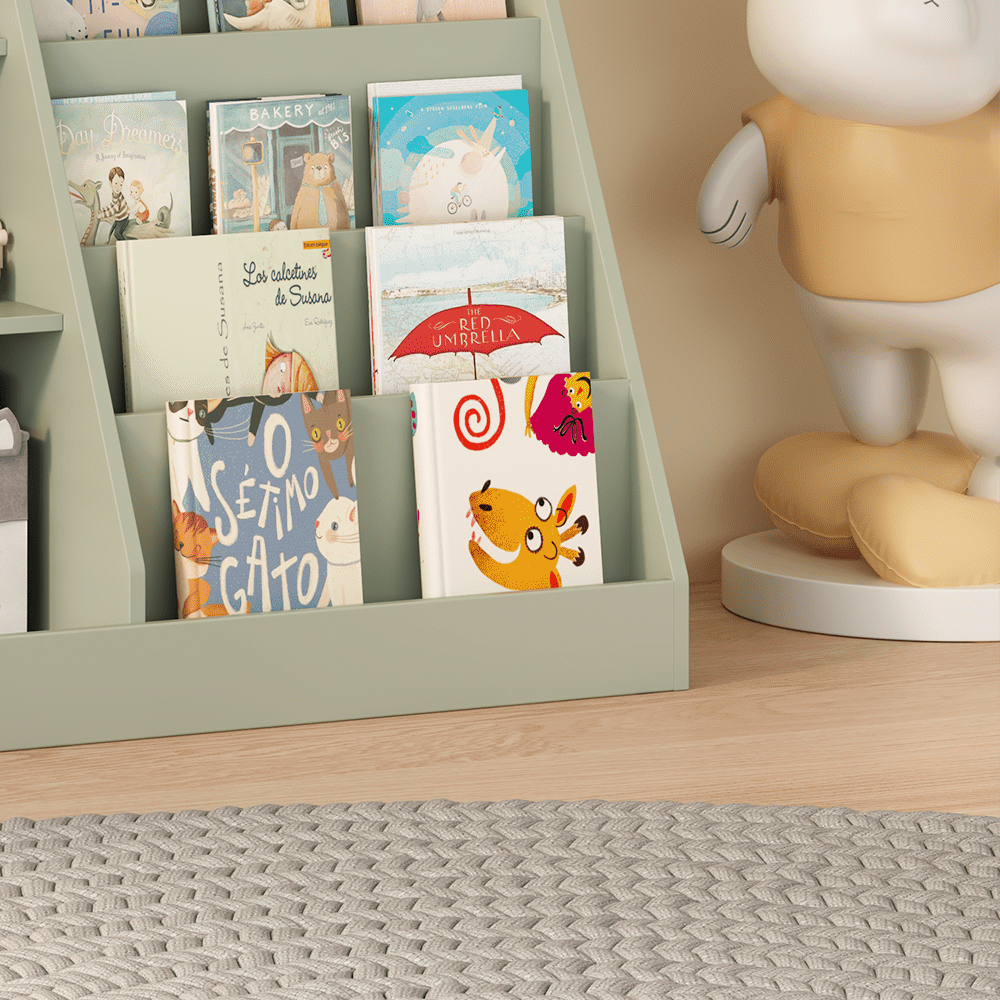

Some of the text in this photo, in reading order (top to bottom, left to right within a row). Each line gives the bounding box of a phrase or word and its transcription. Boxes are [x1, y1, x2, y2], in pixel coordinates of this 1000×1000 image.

[250, 103, 314, 121] BAKERY
[56, 109, 184, 155] Day Dreamers
[243, 261, 318, 287] Los calcetines
[217, 262, 229, 339] Susana
[275, 284, 332, 307] de Susana
[460, 316, 491, 331] RED
[467, 308, 481, 316] THE
[432, 328, 520, 348] UMBRELLA
[219, 345, 229, 369] de
[263, 413, 291, 478] O
[220, 535, 319, 616] GATO
